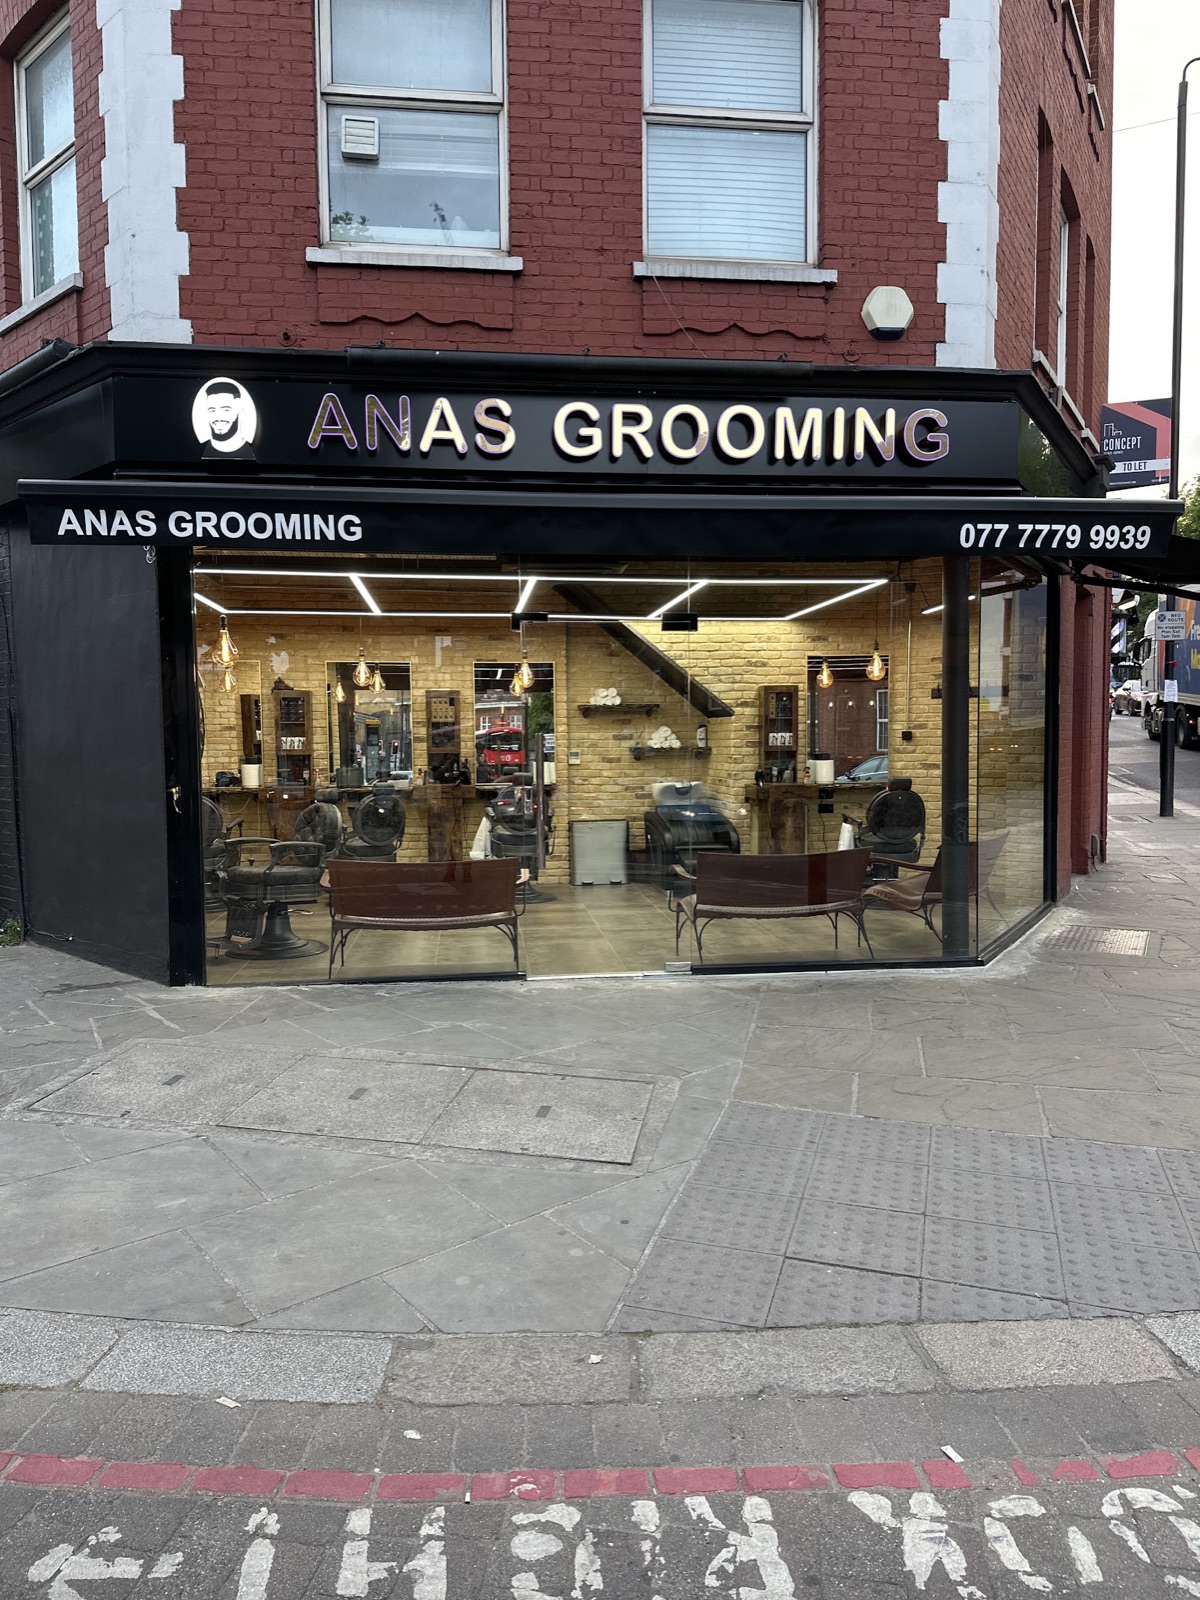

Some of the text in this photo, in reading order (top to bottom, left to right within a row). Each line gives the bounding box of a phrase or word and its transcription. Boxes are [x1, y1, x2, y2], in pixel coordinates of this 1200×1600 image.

[307, 392, 950, 463] ANAS GROOMING
[1103, 436, 1141, 450] CONCEPT
[1122, 461, 1148, 471] TO LET
[57, 508, 364, 543] ANAS GROOMING
[959, 523, 1151, 550] 077 7779 9939
